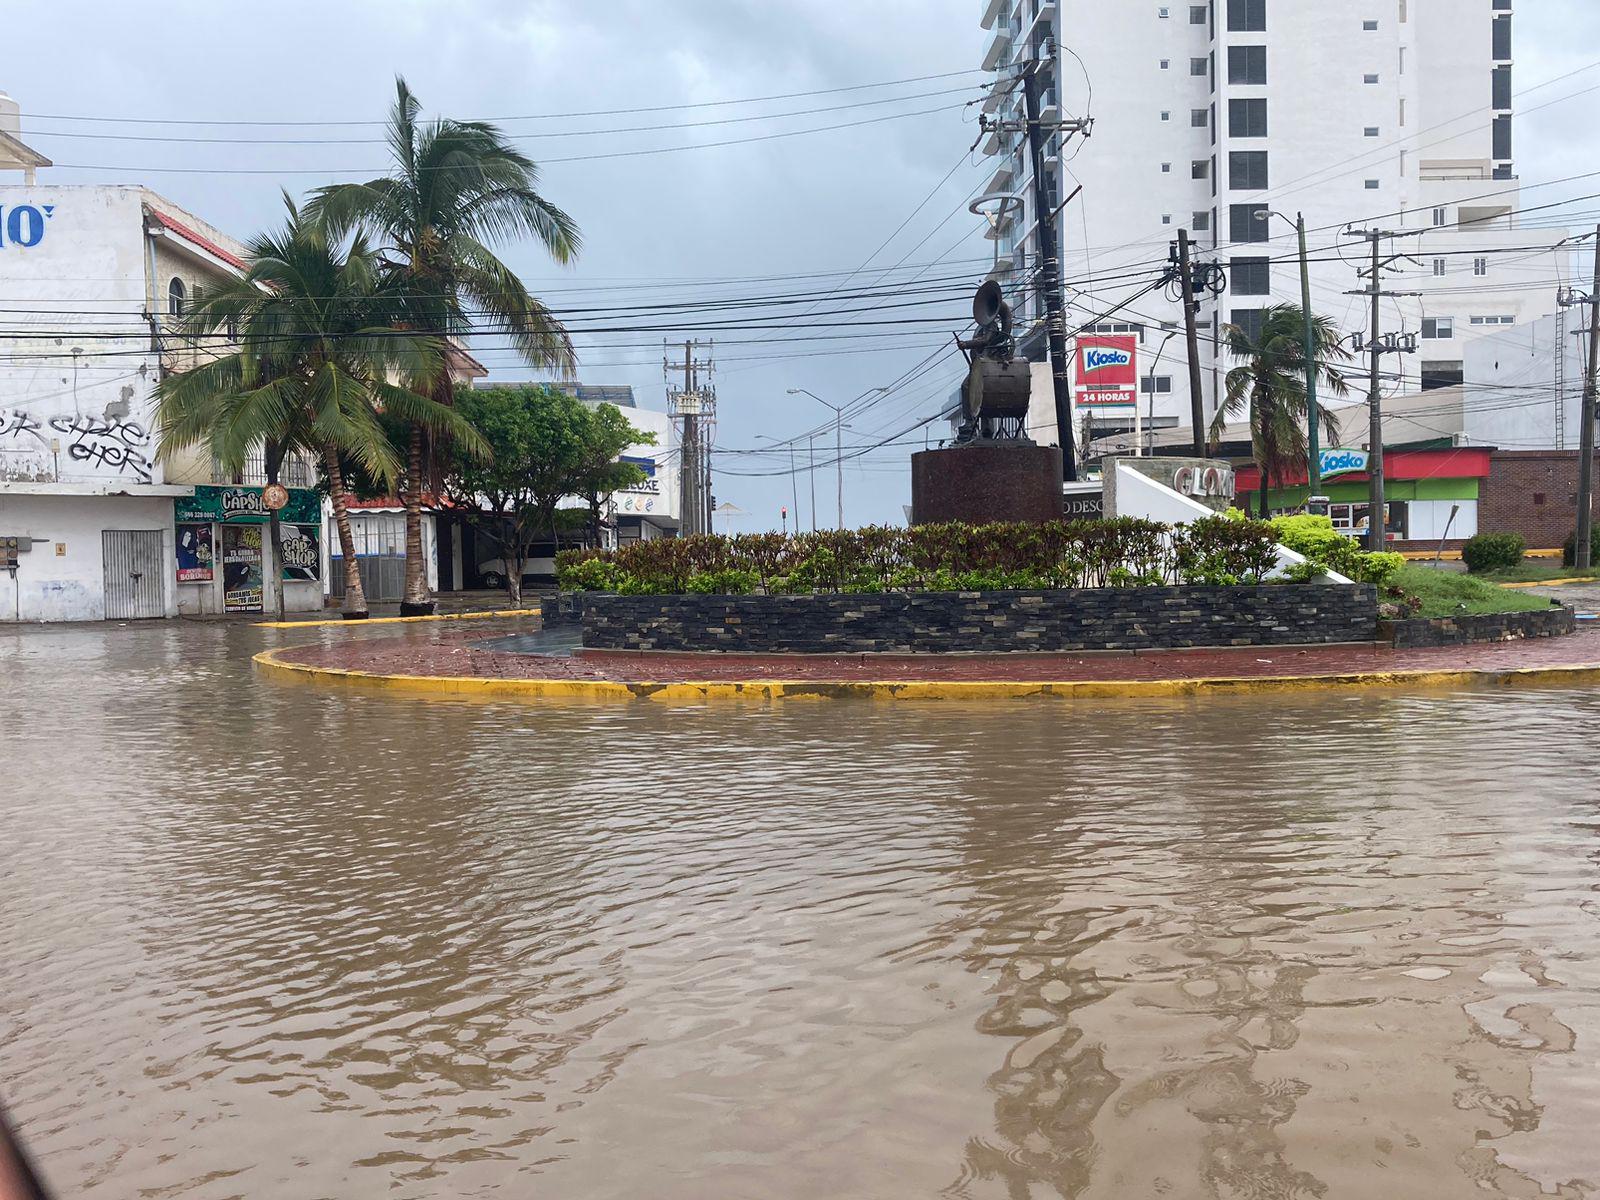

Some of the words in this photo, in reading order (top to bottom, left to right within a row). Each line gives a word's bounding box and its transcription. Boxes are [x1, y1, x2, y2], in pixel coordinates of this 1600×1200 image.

[1087, 350, 1128, 368] Kiosko
[1082, 393, 1096, 402] 24
[1097, 393, 1130, 402] HORAS
[625, 480, 660, 491] LUXE
[222, 490, 271, 512] CAPSH
[282, 538, 309, 551] CAP
[284, 550, 317, 566] SHOP
